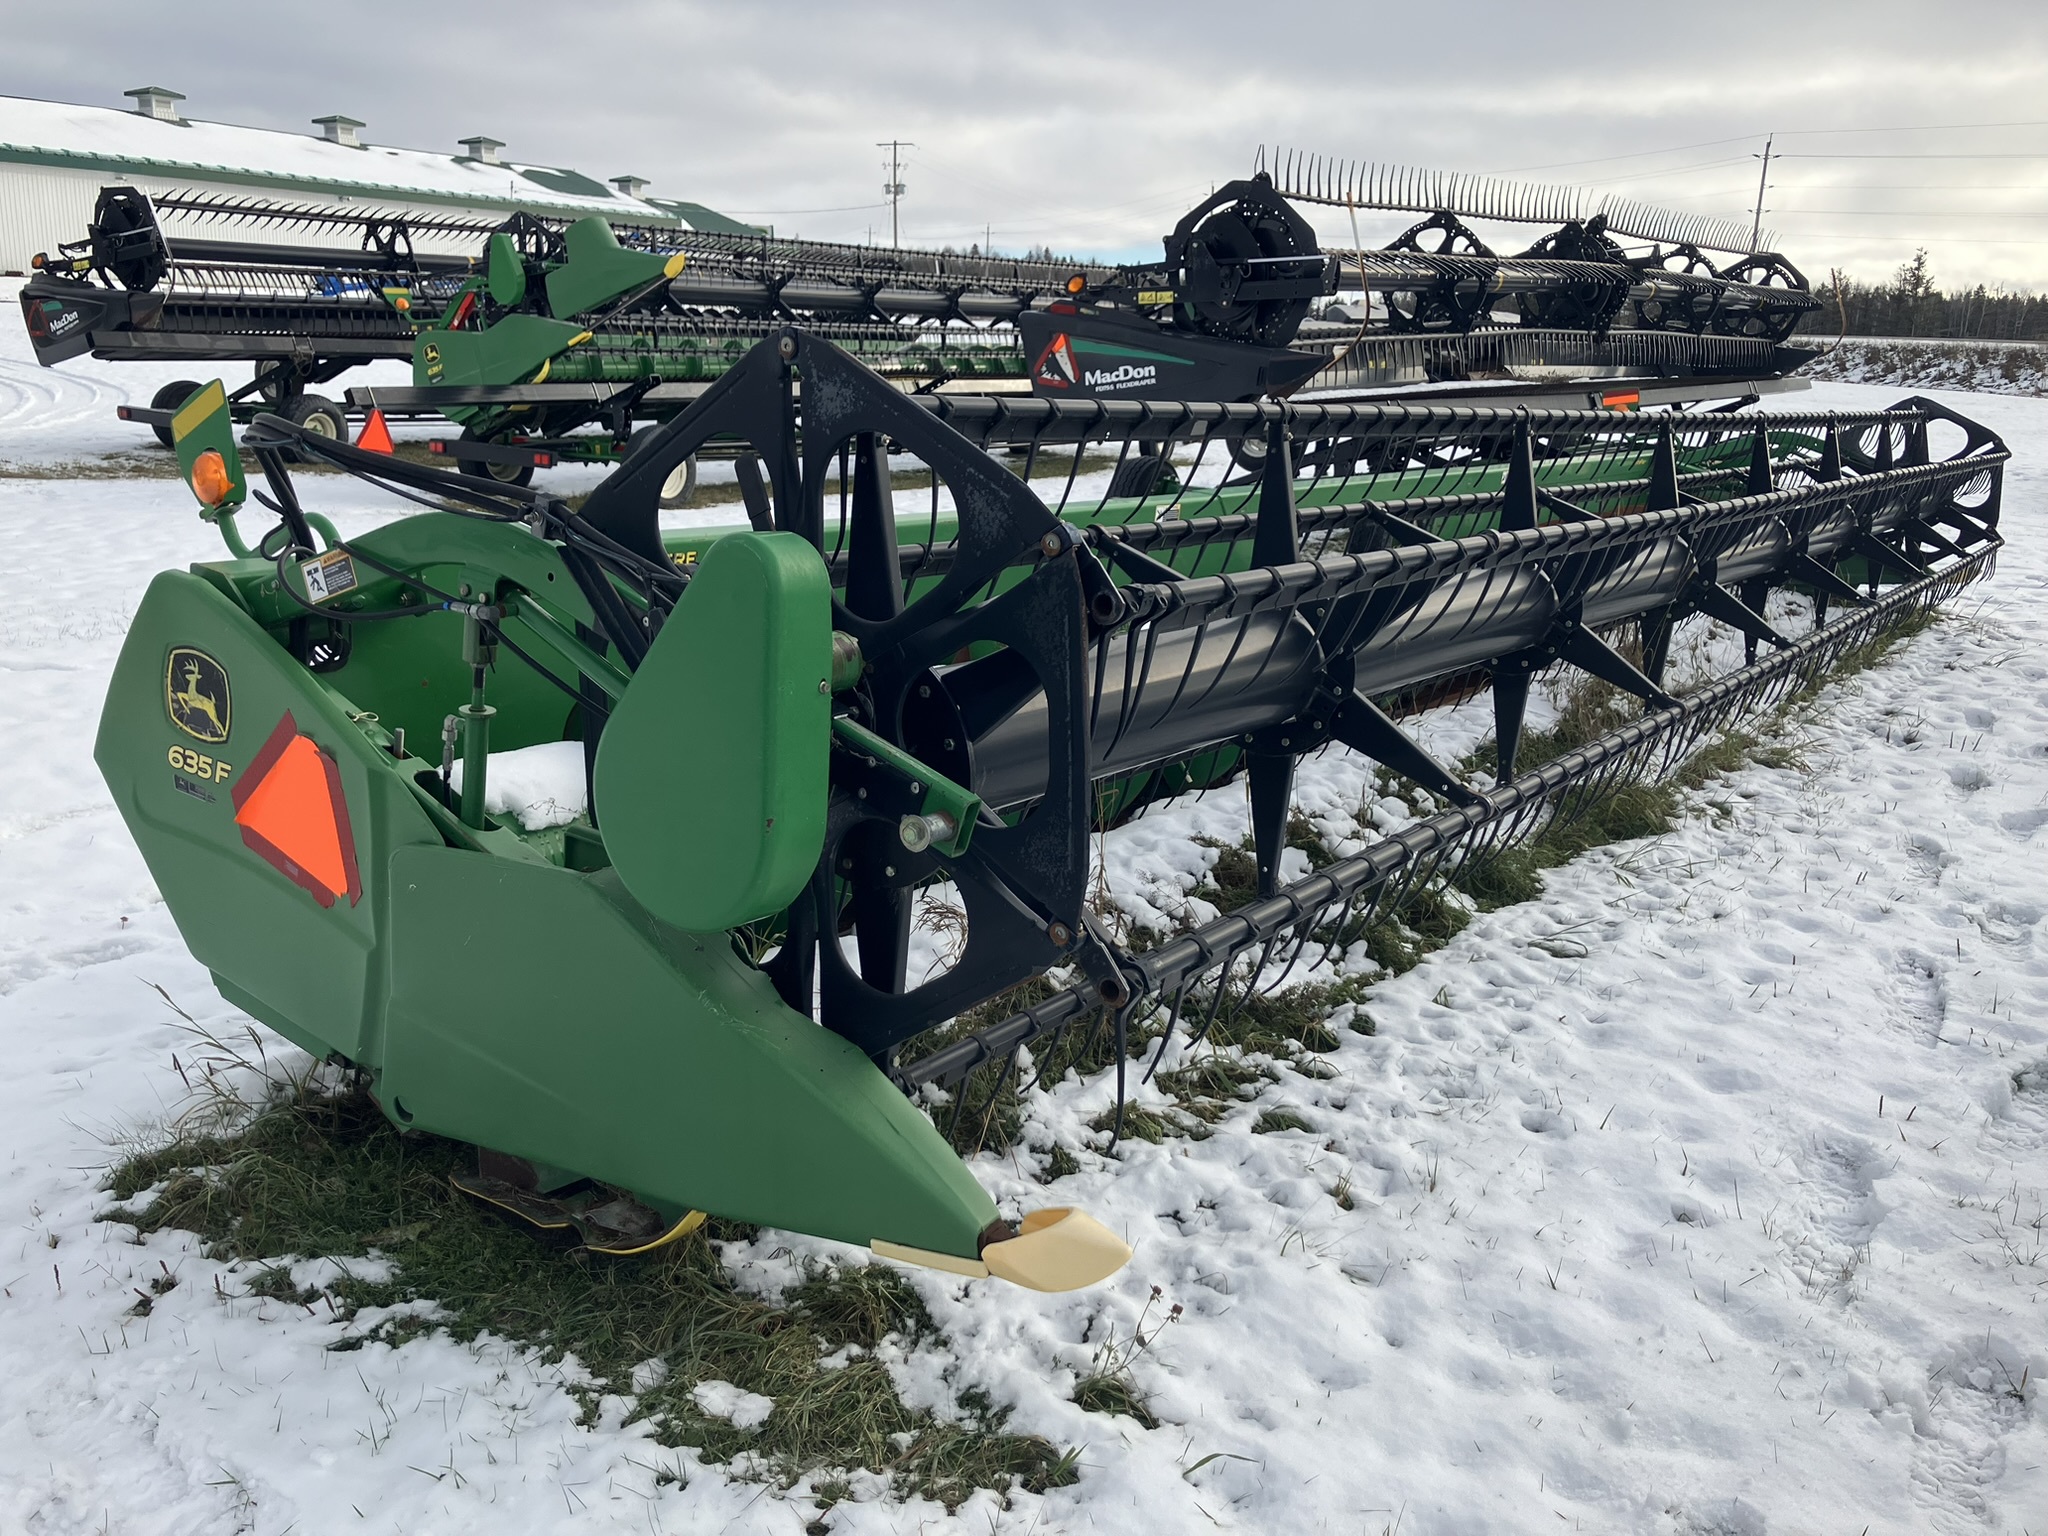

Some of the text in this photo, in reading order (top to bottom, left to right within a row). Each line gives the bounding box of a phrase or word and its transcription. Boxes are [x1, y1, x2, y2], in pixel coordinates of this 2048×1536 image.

[49, 310, 79, 333] MacDon
[1084, 364, 1156, 386] MacDon
[1116, 378, 1157, 390] FLEXDRAPER
